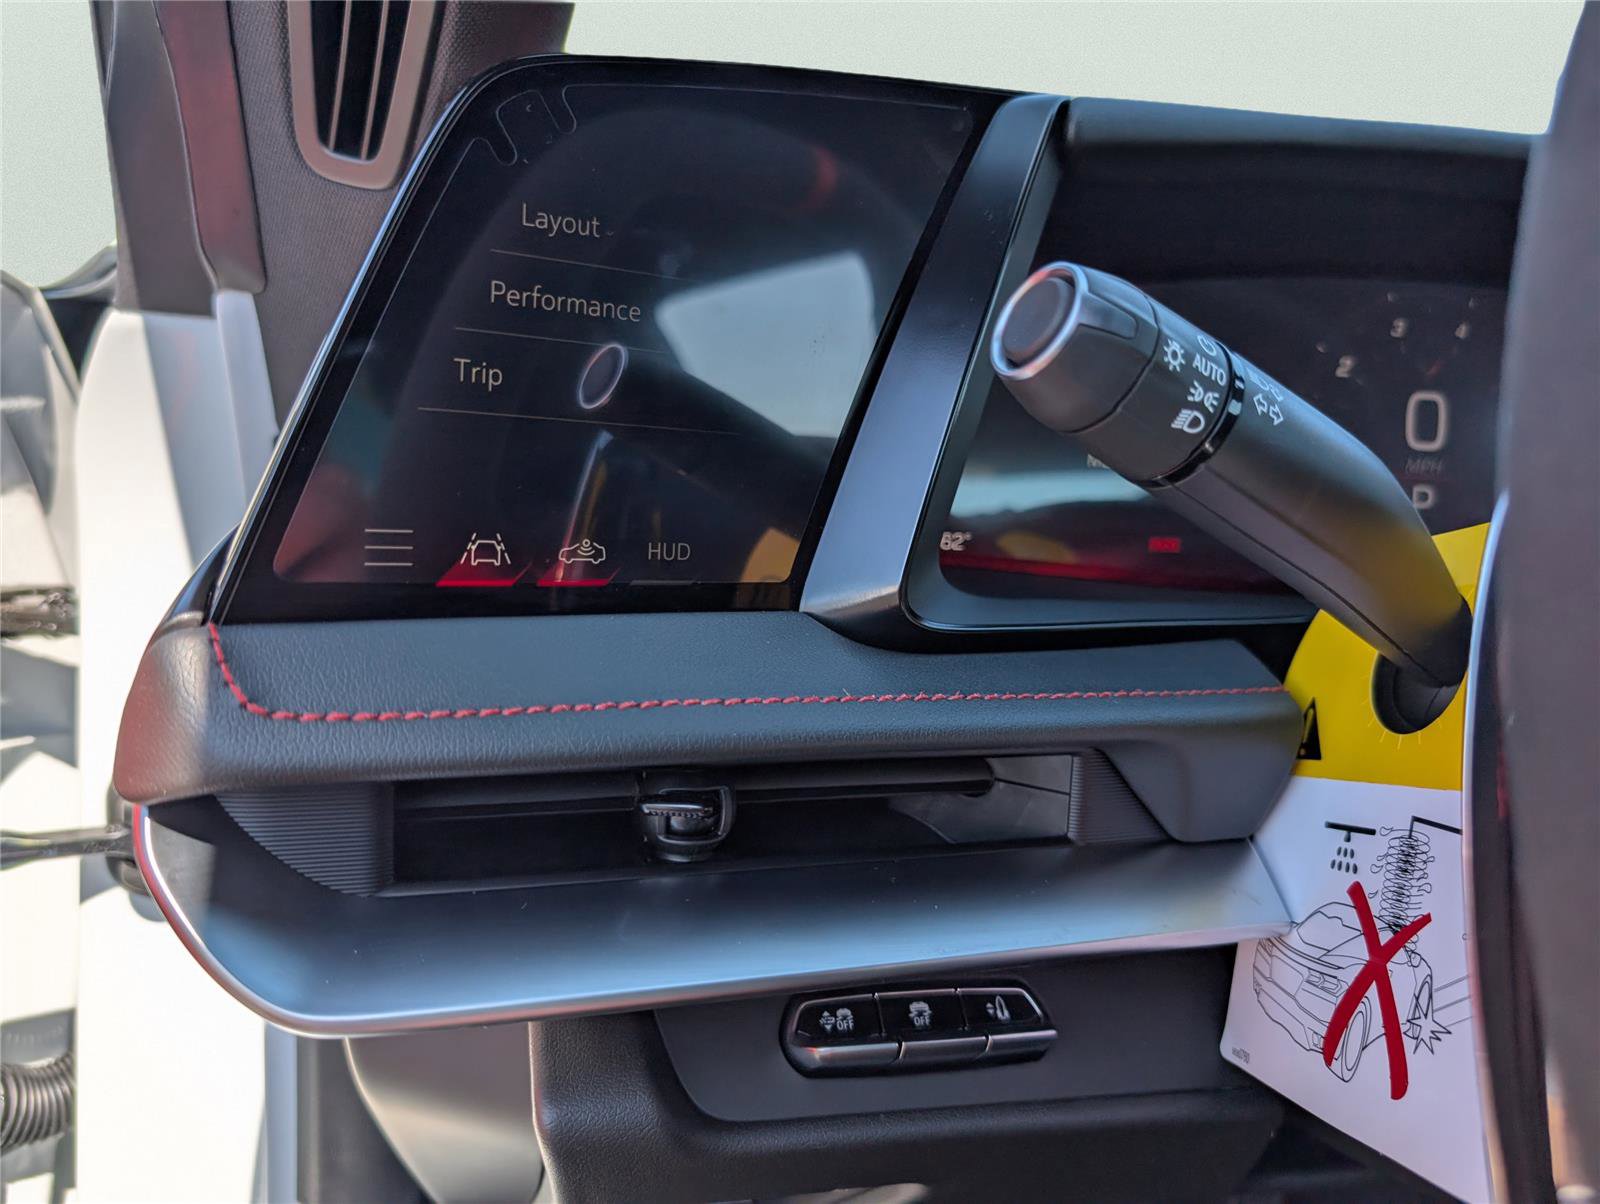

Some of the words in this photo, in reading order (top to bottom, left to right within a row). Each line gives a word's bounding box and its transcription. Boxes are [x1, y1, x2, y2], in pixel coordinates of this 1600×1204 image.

[521, 202, 600, 238] Layout
[490, 280, 641, 323] Performance
[453, 357, 503, 391] Trip
[1192, 354, 1227, 387] AUTO
[1405, 390, 1449, 453] 0
[1412, 483, 1436, 510] P
[647, 542, 692, 561] HUD
[836, 1019, 855, 1032] OFF
[913, 1014, 931, 1027] OFF
